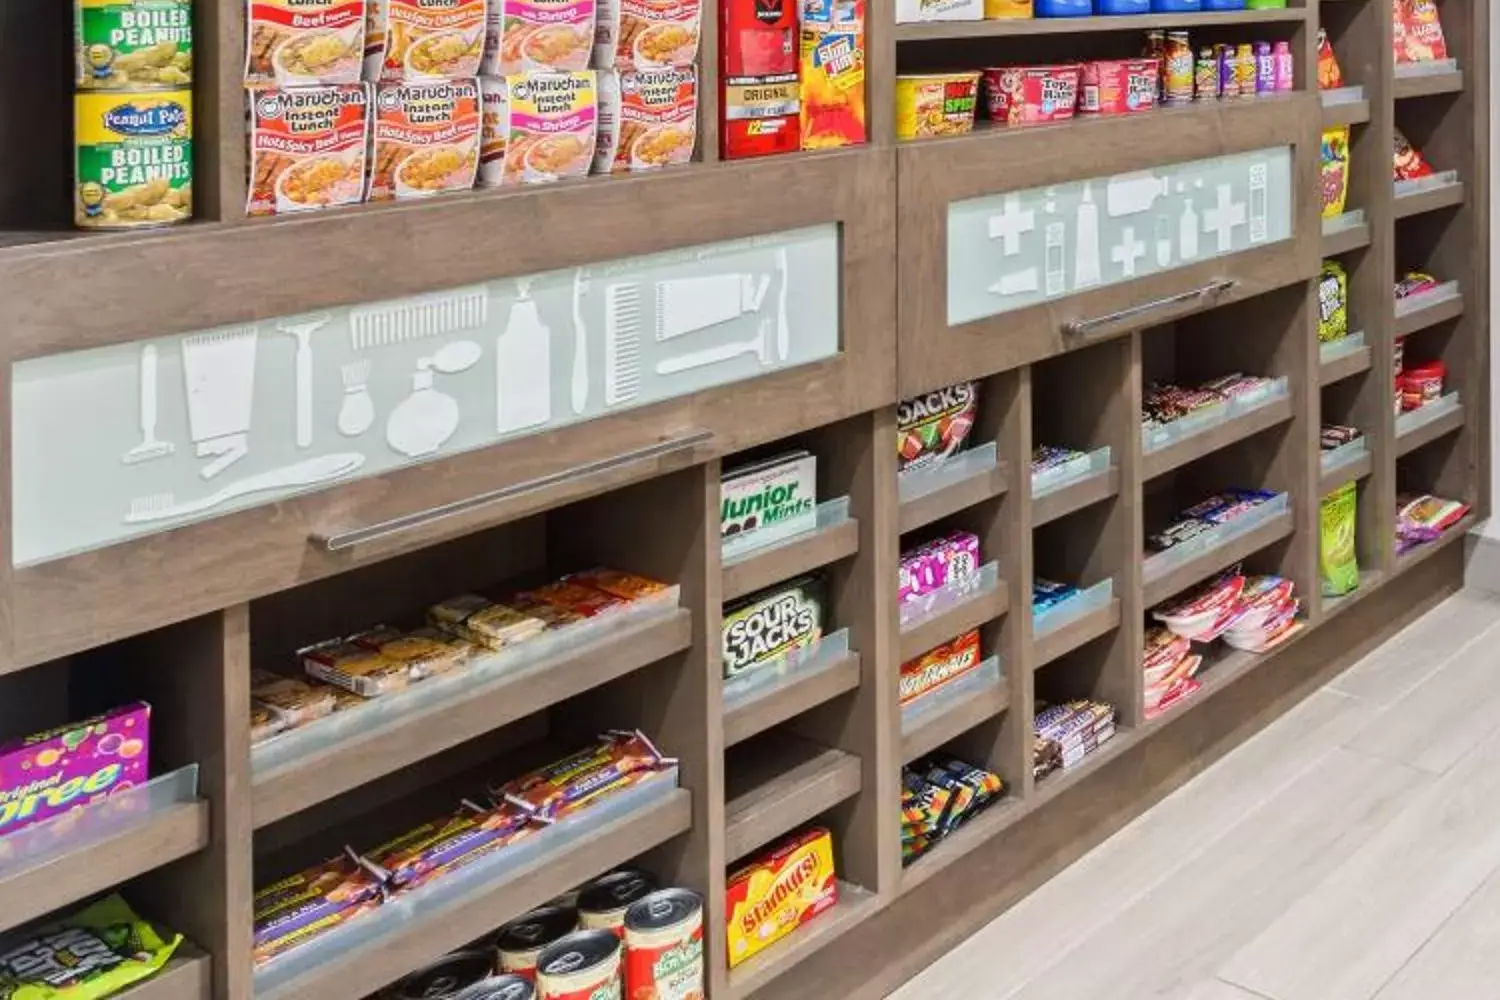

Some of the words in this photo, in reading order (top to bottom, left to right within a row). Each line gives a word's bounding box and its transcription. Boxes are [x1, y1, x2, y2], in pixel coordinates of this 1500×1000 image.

[121, 10, 188, 29] BOILED
[110, 28, 192, 46] PEANUTS
[527, 78, 591, 92] Maruchan
[634, 71, 695, 85] Maruchan
[278, 89, 361, 107] Maruchan
[396, 86, 473, 102] Maruchan
[533, 94, 576, 105] Instant
[285, 110, 339, 121] Instant
[403, 102, 455, 113] Instant
[103, 112, 154, 128] Peanut
[291, 120, 334, 132] Lunch
[409, 112, 451, 124] Lunch
[111, 145, 184, 168] BOILED
[101, 162, 190, 184] PEANUTS
[728, 596, 799, 643] SOUR
[734, 609, 814, 668] JACKS
